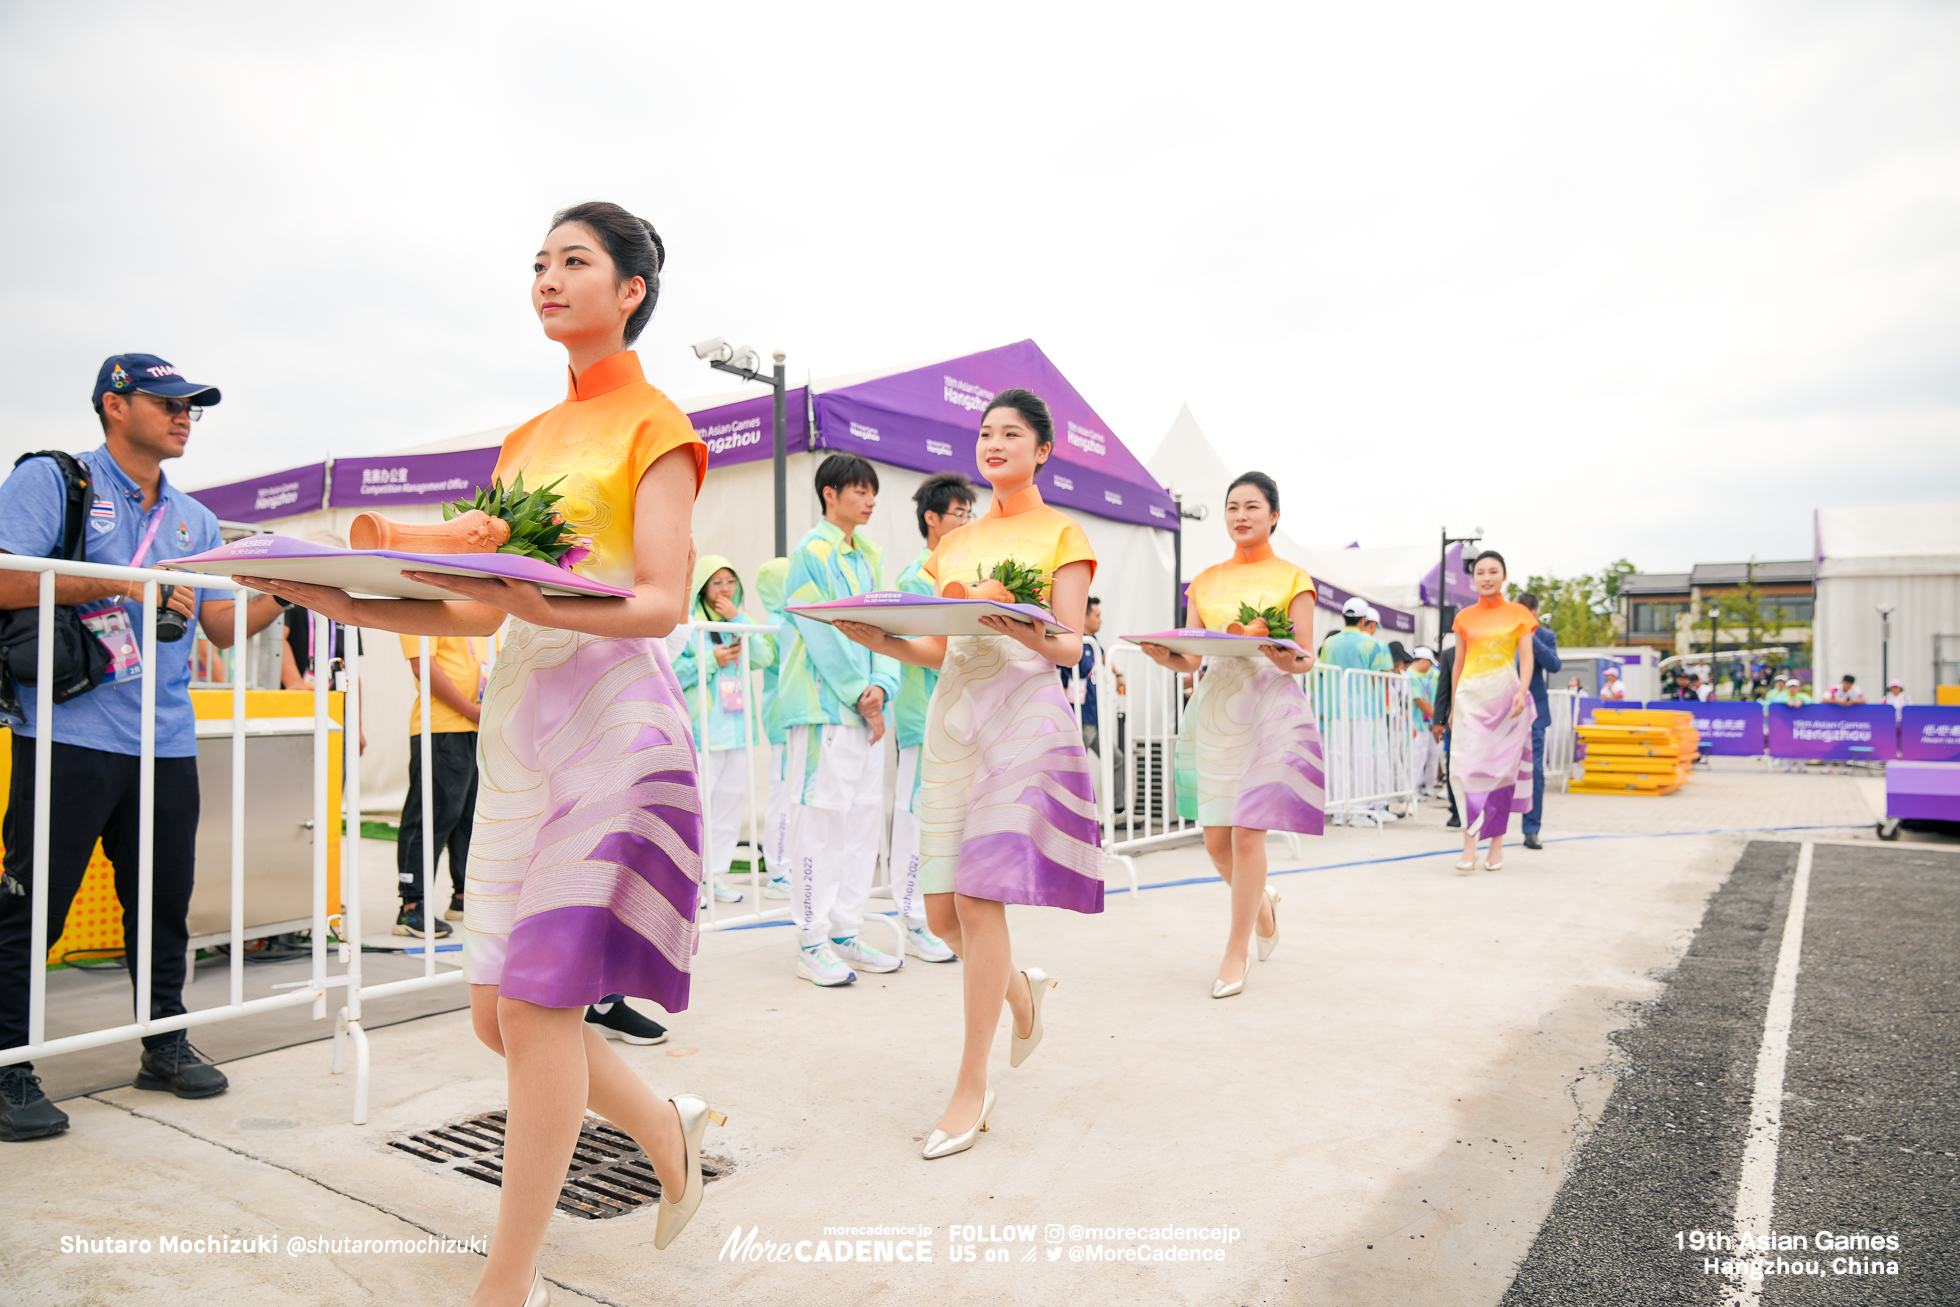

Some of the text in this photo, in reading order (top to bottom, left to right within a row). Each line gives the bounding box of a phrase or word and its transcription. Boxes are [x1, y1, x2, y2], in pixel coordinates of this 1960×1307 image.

[943, 385, 989, 412] Hangzho
[957, 379, 974, 394] Asian
[974, 384, 995, 401] Games
[707, 425, 731, 437] Asian
[731, 417, 761, 432] Games
[706, 429, 761, 454] ngzhou
[1067, 430, 1106, 457] Hangzhou
[360, 477, 469, 496] Competition Management Office
[1792, 728, 1872, 743] Hangzhou
[1813, 720, 1837, 729] Asian
[1838, 720, 1871, 730] Games
[803, 856, 813, 881] 2022
[907, 854, 919, 879] 2022
